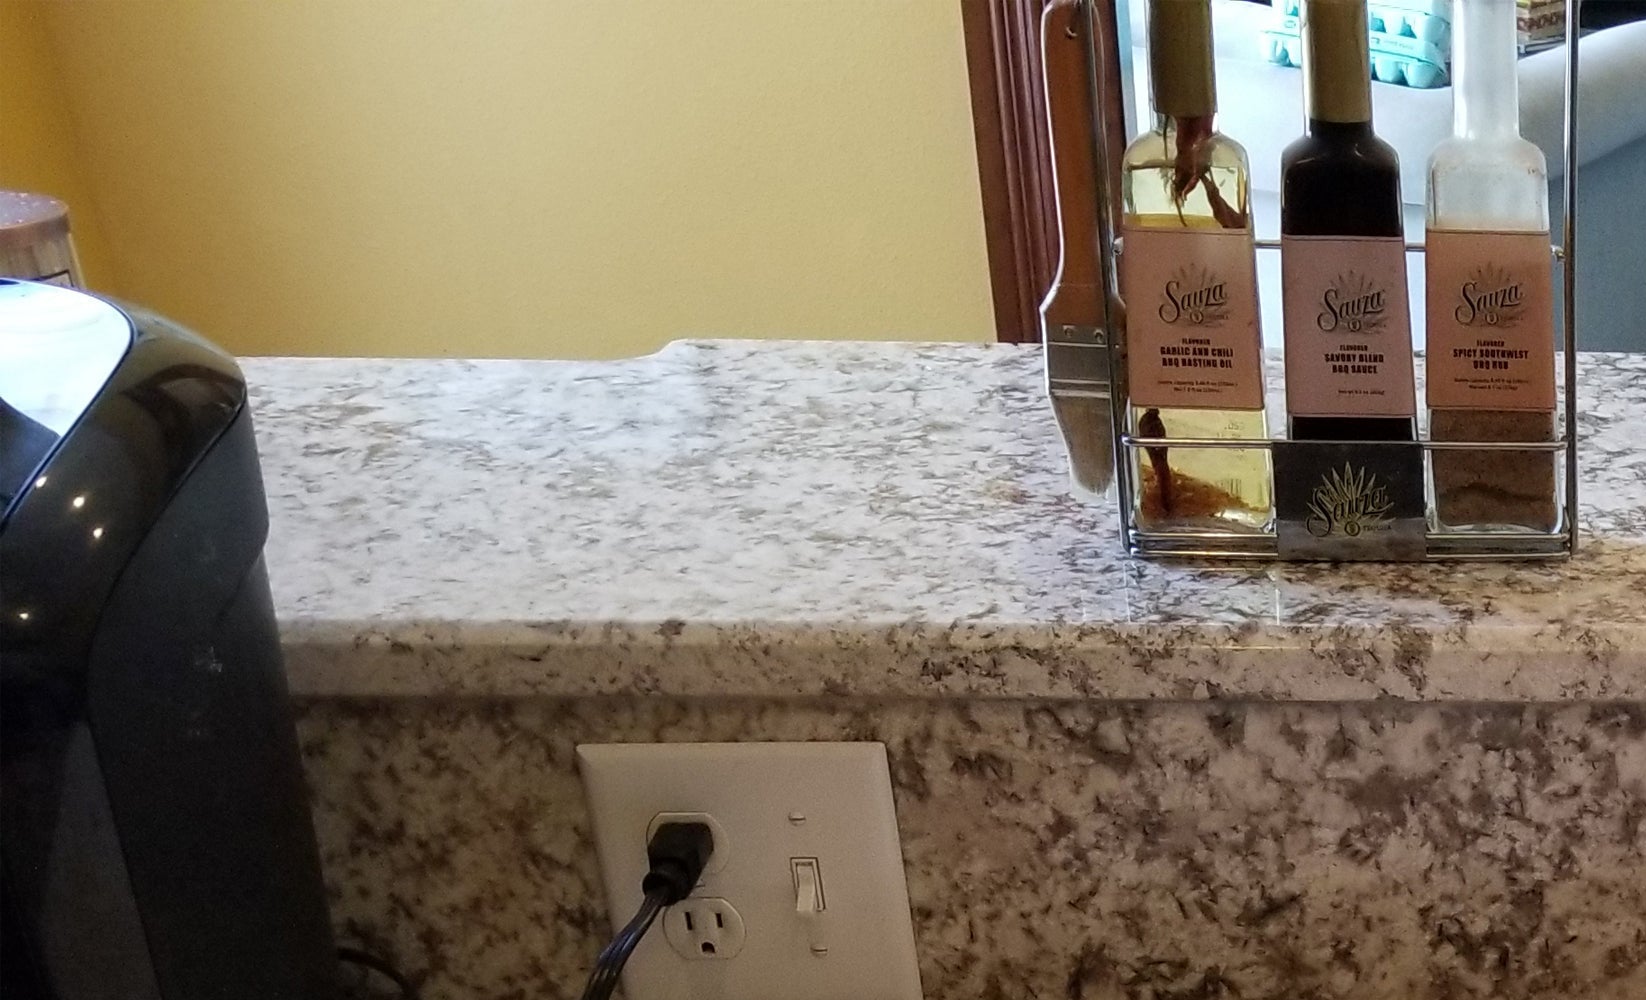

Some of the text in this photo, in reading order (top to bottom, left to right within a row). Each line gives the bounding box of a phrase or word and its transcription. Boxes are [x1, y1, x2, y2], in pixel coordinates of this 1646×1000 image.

[1158, 280, 1227, 324] Sauza
[1454, 281, 1522, 326] Sauza
[1317, 288, 1385, 332] Sauza
[1160, 346, 1234, 358] GARLIC AND CHILI
[1324, 353, 1384, 363] SAVORY BLEND
[1453, 348, 1529, 360] SPICY SOUTHWEST
[1161, 357, 1233, 369] BBQ BASTING OIL
[1331, 364, 1378, 374] BBQ SAUCE
[1472, 360, 1509, 370] BBQ RUB
[1306, 487, 1387, 537] Sauza
